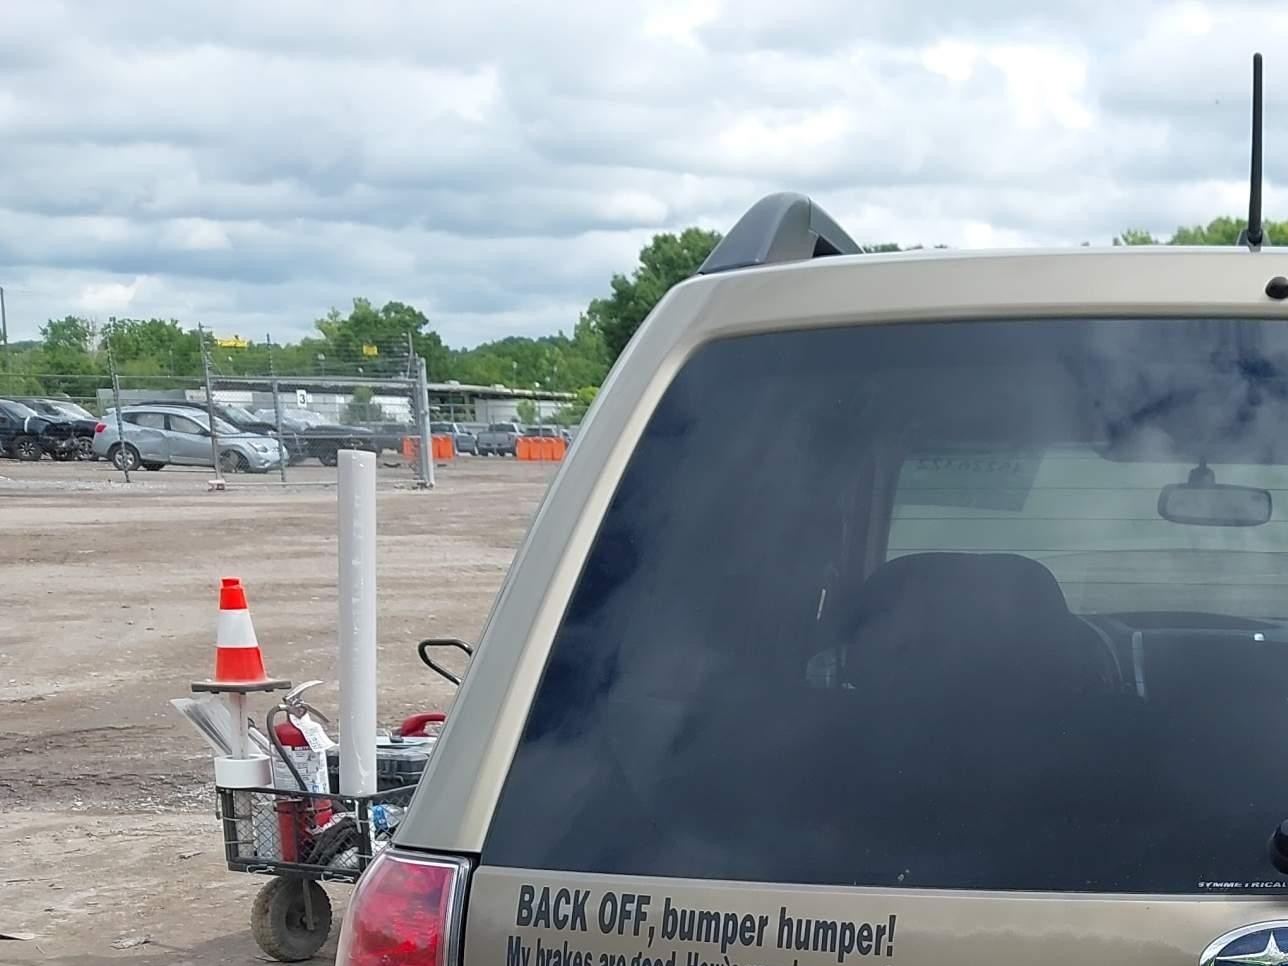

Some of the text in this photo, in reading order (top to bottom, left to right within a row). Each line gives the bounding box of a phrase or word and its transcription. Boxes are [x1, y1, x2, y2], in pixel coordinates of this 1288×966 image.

[1198, 880, 1287, 889] SYMMETRICAL
[516, 884, 897, 963] BACK OFF, bumper humper!
